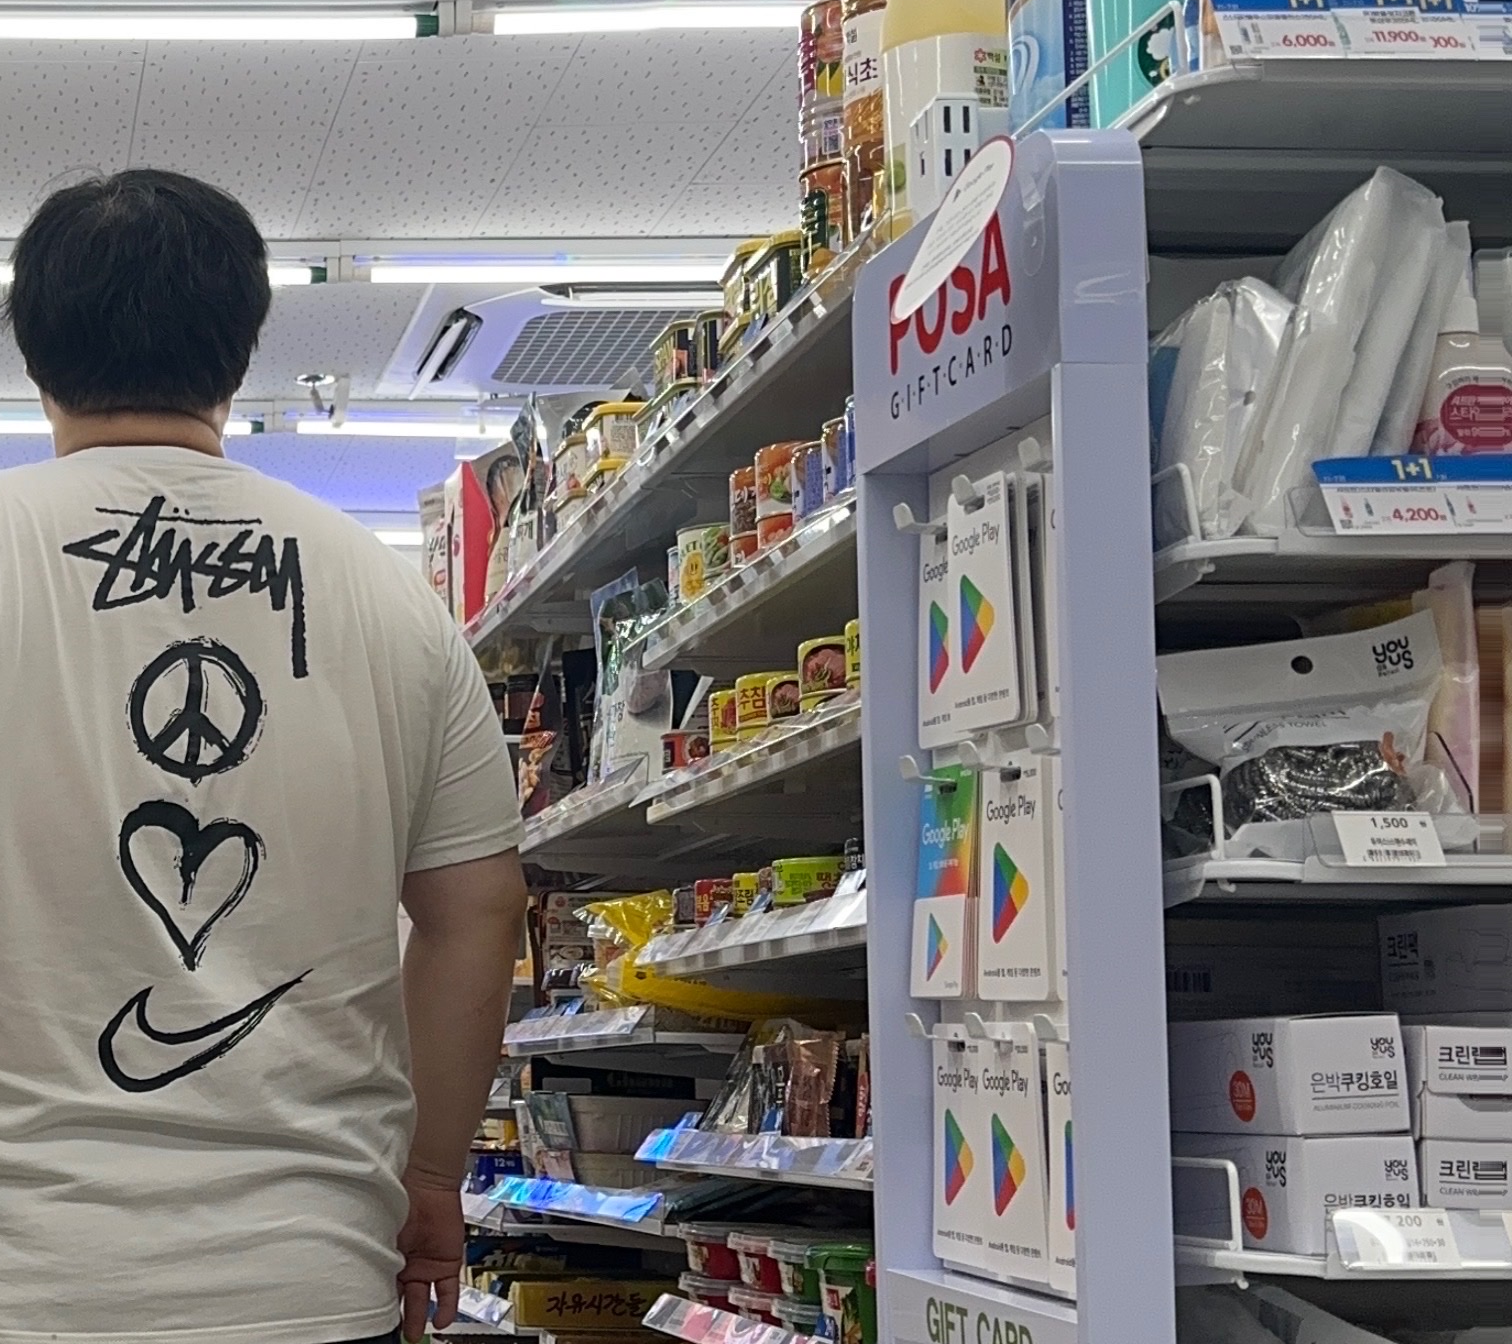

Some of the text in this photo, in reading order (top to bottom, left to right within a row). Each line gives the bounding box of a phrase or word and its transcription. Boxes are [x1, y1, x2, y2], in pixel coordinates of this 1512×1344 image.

[1390, 457, 1433, 481] 1+1
[952, 521, 1001, 557] Google Play
[923, 557, 949, 584] Google
[986, 794, 1037, 824] Google Play
[1370, 816, 1409, 830] 1,500
[921, 817, 970, 850] Google Play
[937, 1065, 979, 1093] Google Play
[982, 1068, 1029, 1097] Google Play
[1310, 1069, 1399, 1094] 은박쿠킹호일
